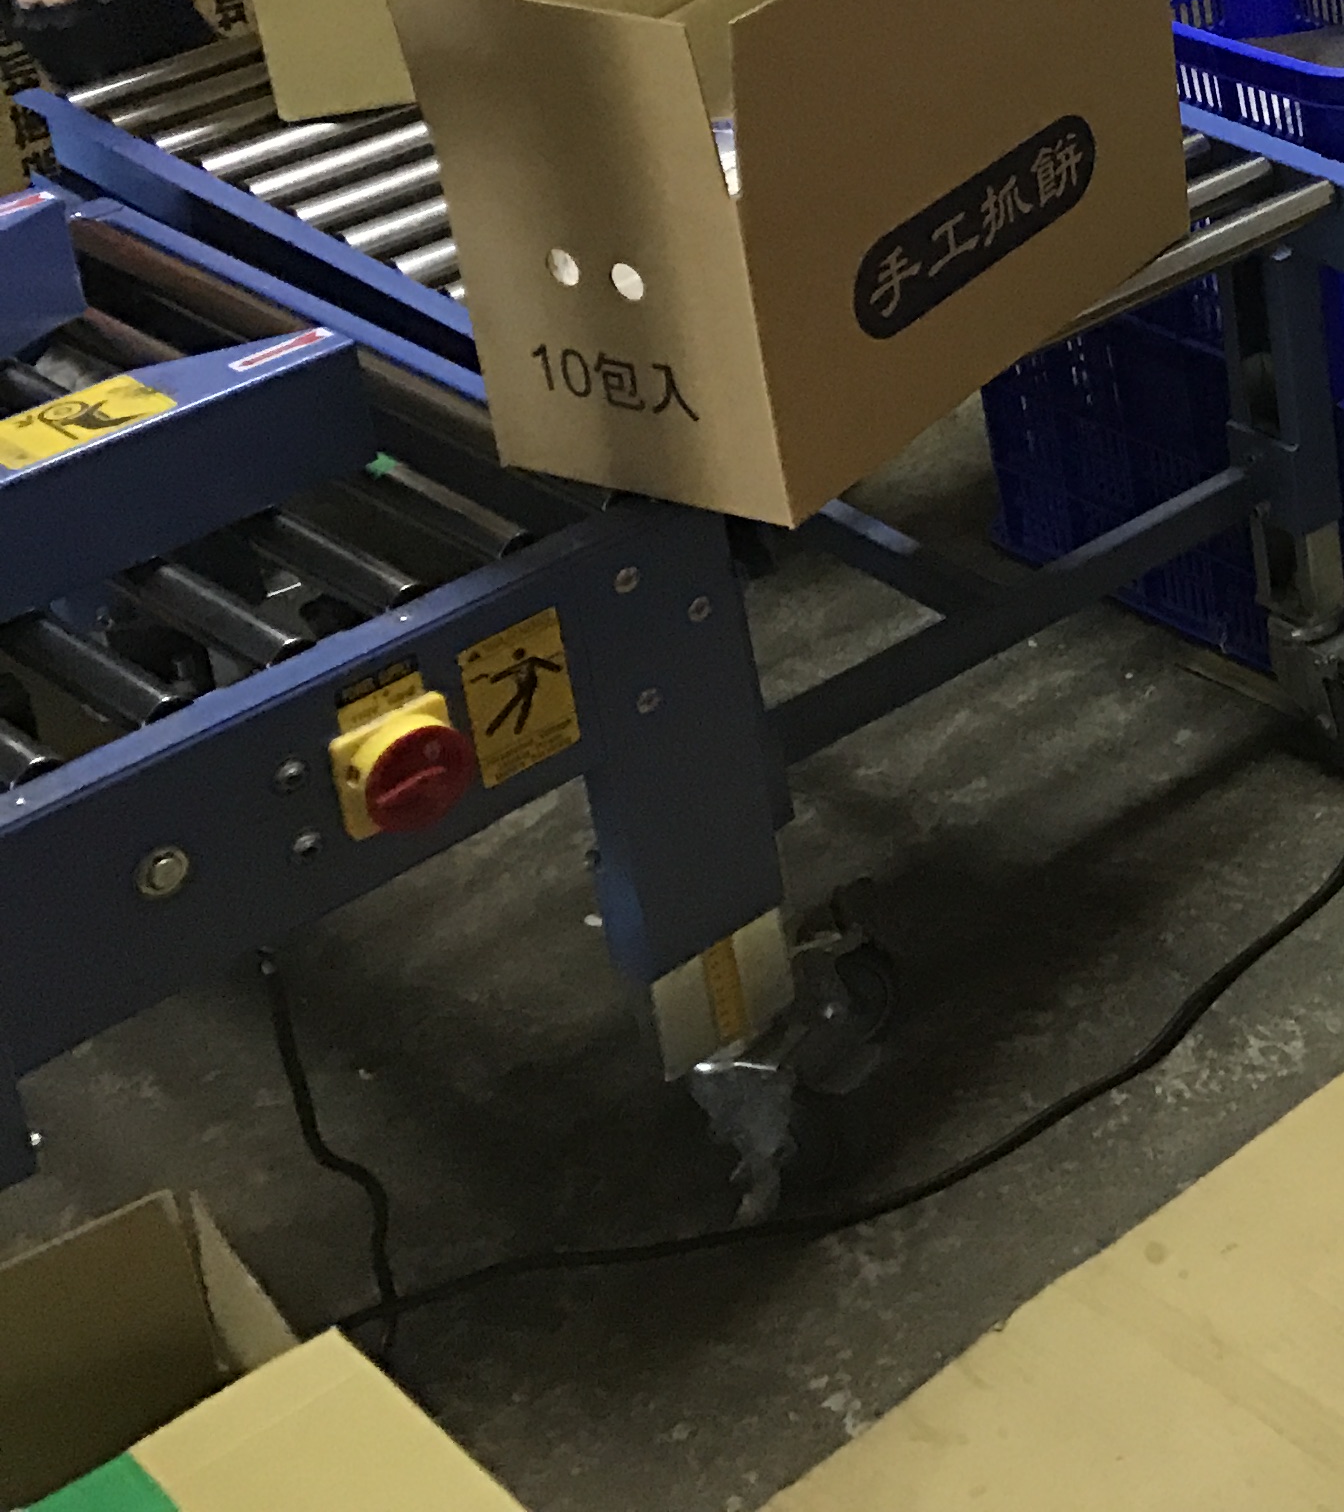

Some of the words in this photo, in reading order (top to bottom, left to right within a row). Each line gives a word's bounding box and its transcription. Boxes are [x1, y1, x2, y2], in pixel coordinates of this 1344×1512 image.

[869, 132, 1085, 319] 手工抓餅
[531, 343, 700, 422] 10包入
